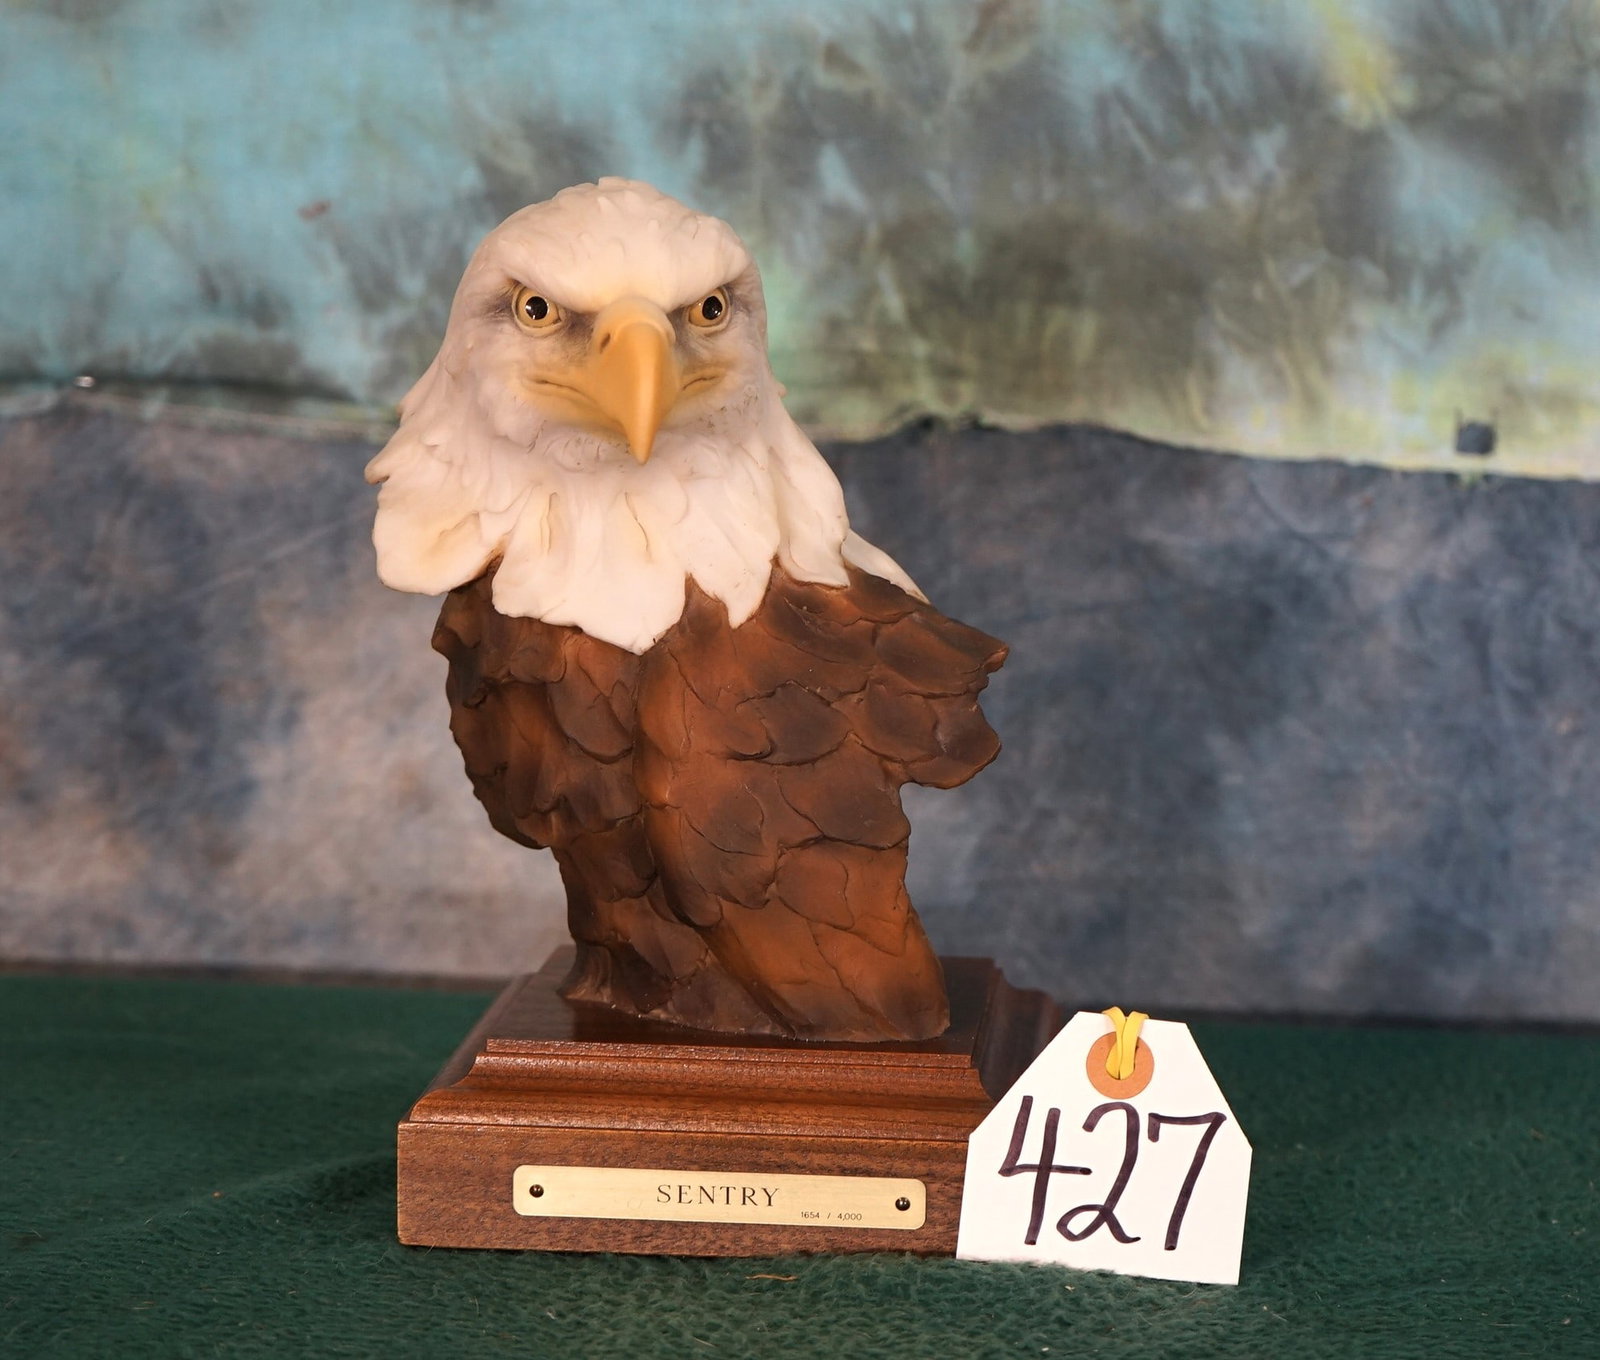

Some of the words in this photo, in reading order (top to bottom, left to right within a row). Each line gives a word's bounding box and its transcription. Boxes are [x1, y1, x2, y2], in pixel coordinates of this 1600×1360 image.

[998, 1095, 1227, 1251] 427
[656, 1184, 780, 1208] SENTRY
[801, 1211, 820, 1219] 1654
[837, 1212, 862, 1221] 4,000
